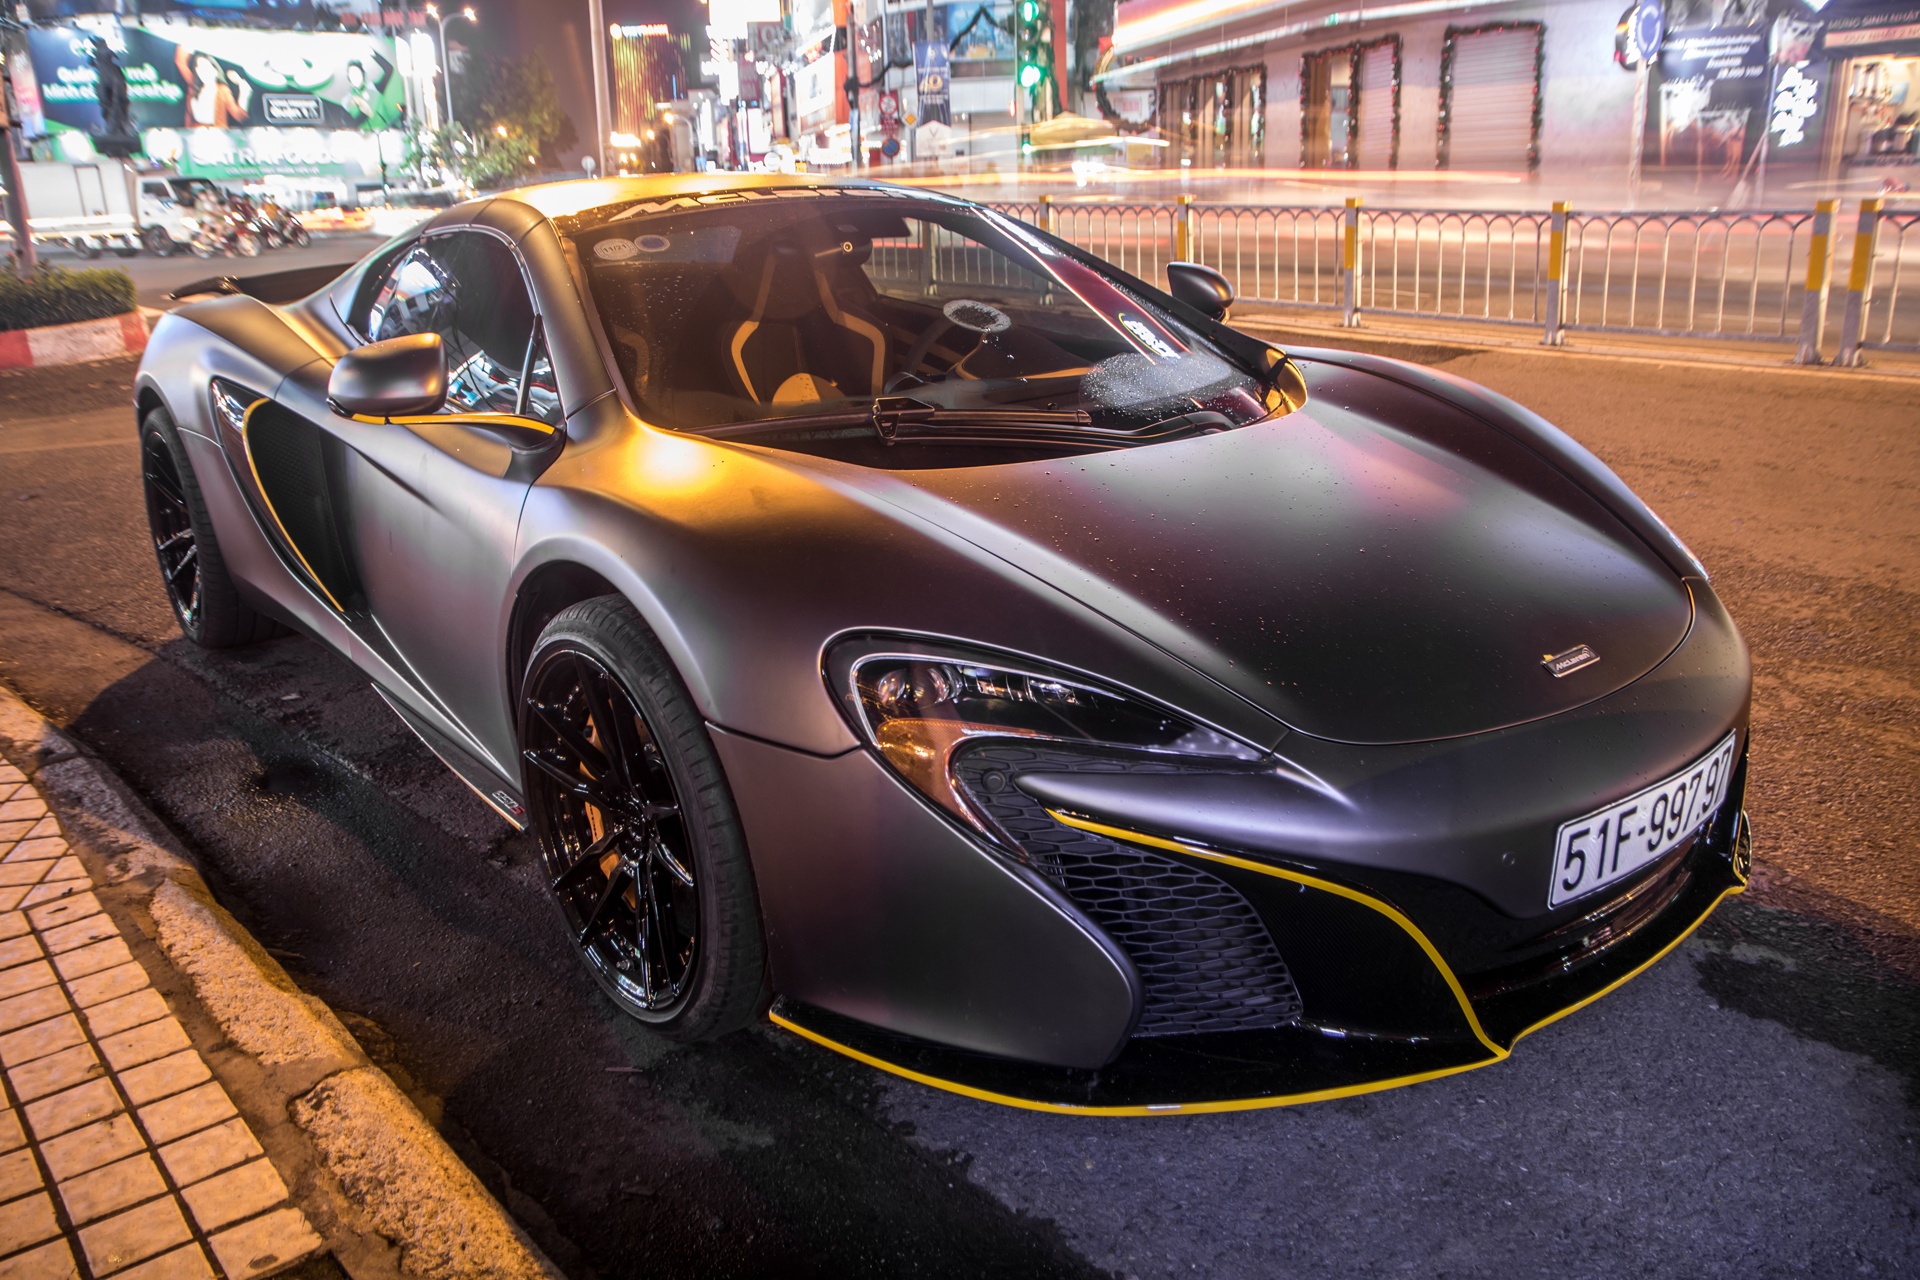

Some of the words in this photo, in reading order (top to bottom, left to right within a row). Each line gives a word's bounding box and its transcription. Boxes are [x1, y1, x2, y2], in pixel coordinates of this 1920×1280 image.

[602, 244, 628, 253] 11/21
[1556, 652, 1590, 671] McLaren
[1562, 743, 1732, 892] 51F-997.97
